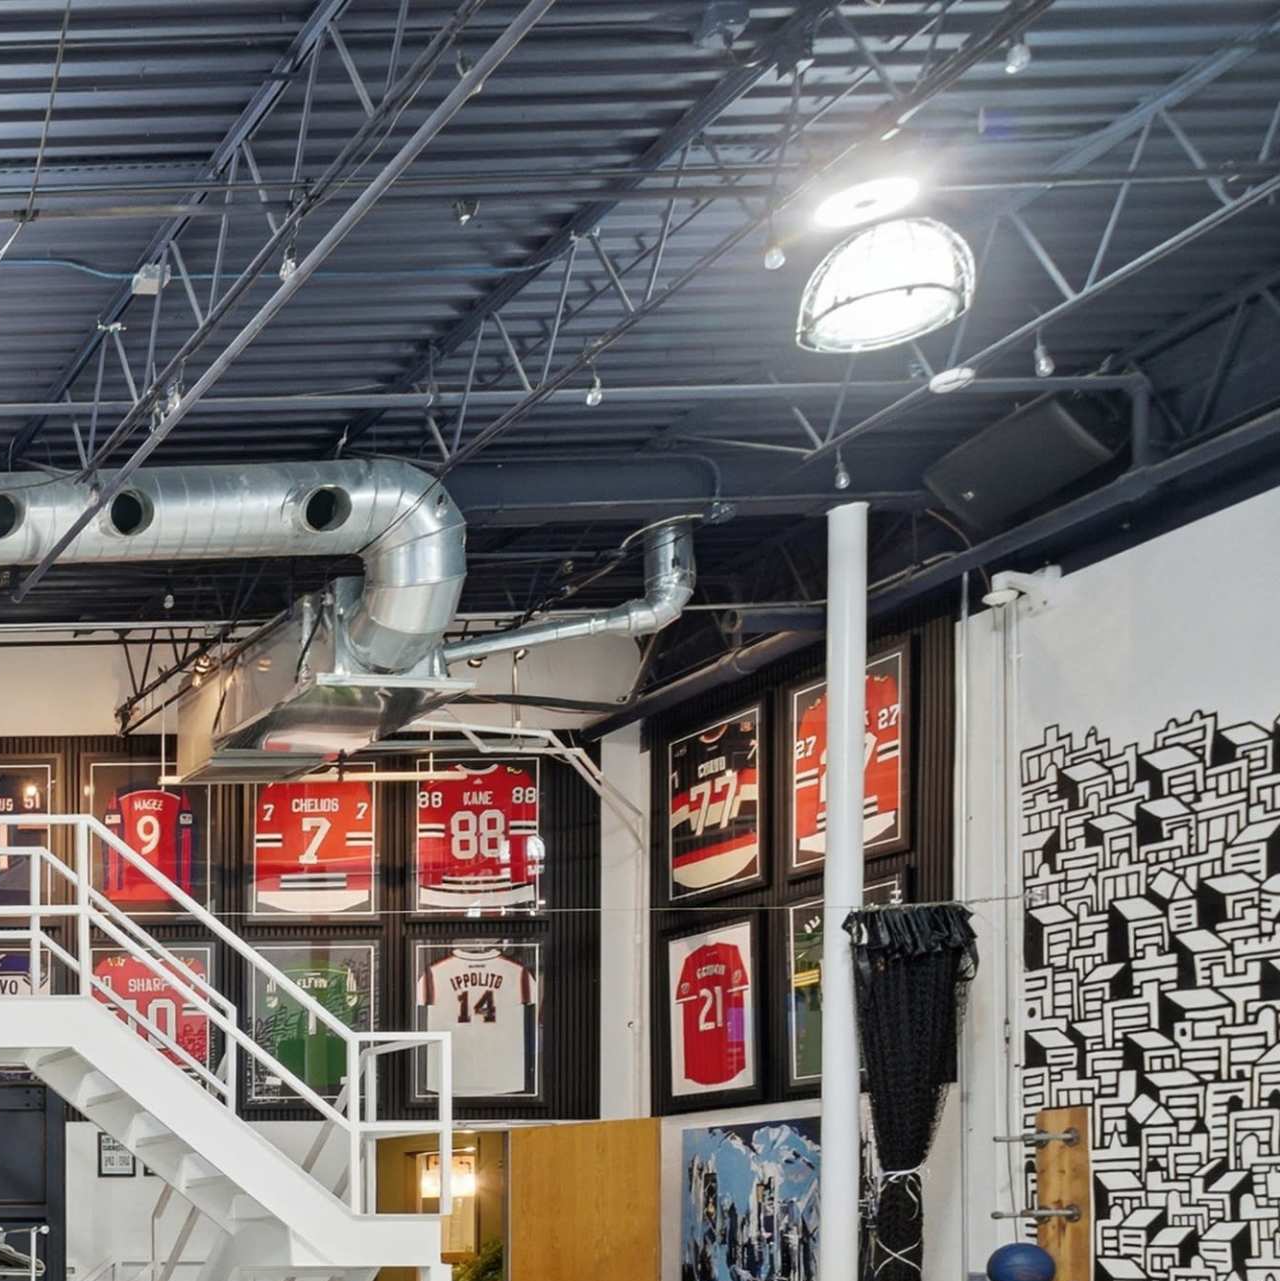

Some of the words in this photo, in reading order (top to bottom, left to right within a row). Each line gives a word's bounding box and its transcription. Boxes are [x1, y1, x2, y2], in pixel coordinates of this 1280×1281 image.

[877, 704, 899, 731] 27
[796, 736, 817, 760] 27
[291, 798, 339, 813] CHELIOS
[418, 791, 443, 808] 88
[462, 791, 494, 806] KANE
[511, 786, 537, 804] 88
[690, 769, 738, 836] 77
[263, 804, 275, 822] 7
[356, 802, 369, 820] 7
[136, 815, 161, 855] 9
[298, 816, 332, 865] 7
[450, 808, 507, 860] 88
[449, 971, 503, 991] IPPOLITO
[457, 990, 496, 1023] 14
[698, 986, 723, 1033] 21
